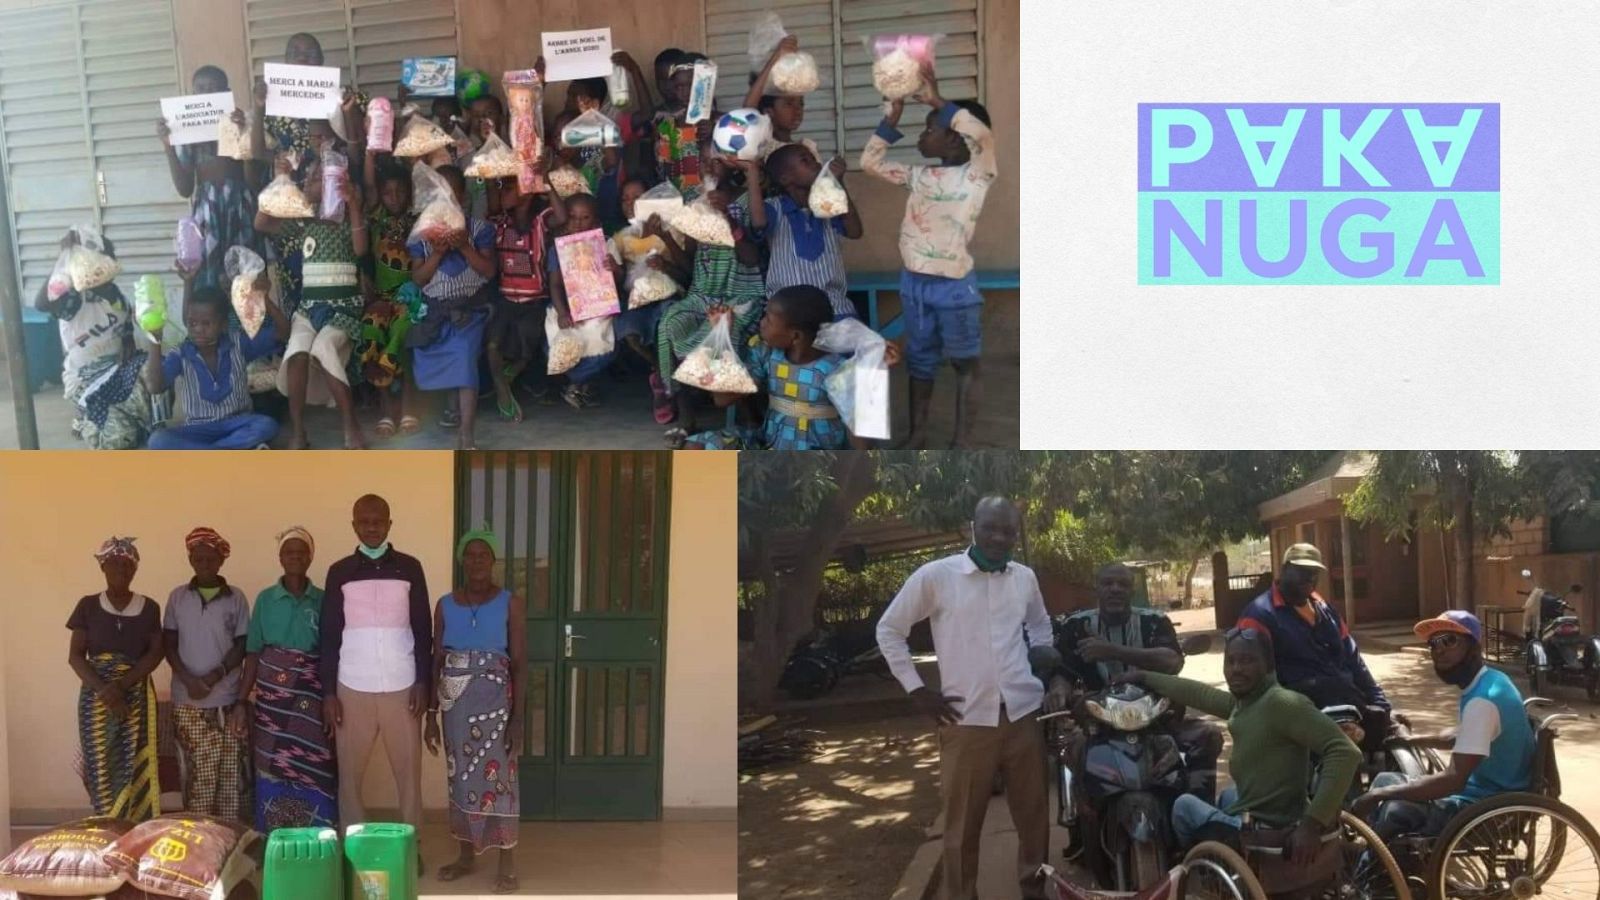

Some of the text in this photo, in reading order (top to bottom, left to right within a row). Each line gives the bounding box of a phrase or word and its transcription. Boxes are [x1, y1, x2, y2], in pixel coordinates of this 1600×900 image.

[269, 77, 335, 89] MERCI A MARIA
[280, 90, 326, 100] MERCEDES
[75, 312, 118, 348] FILA
